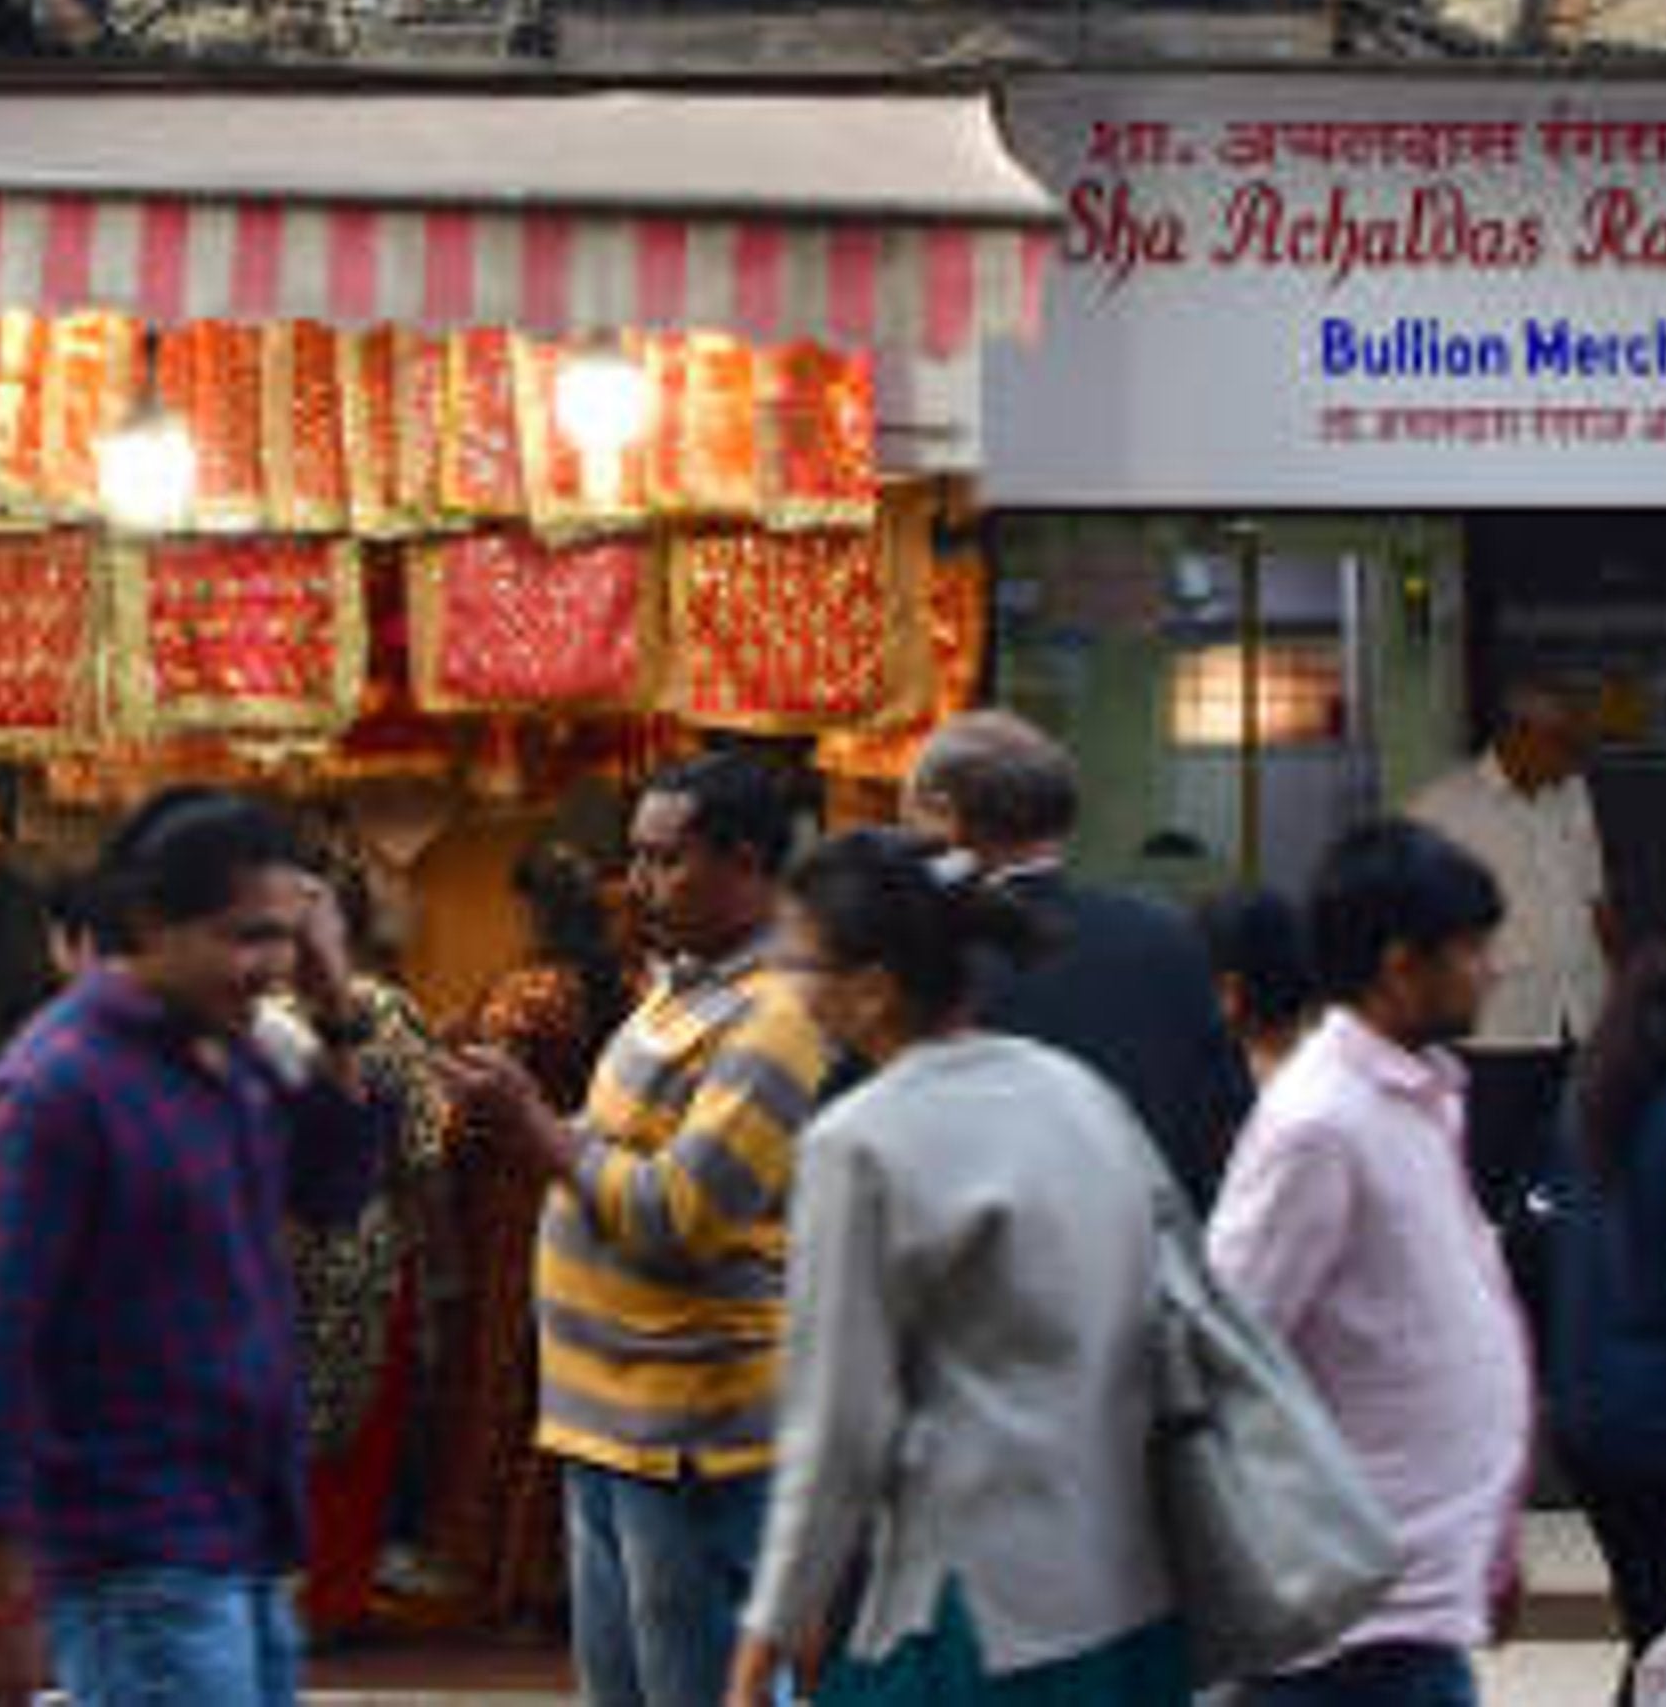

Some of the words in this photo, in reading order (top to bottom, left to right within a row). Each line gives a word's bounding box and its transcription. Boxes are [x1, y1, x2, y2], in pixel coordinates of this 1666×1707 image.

[1065, 180, 1185, 292] Sha
[1211, 180, 1540, 289] Achaldas
[1321, 318, 1511, 377] Bullion
